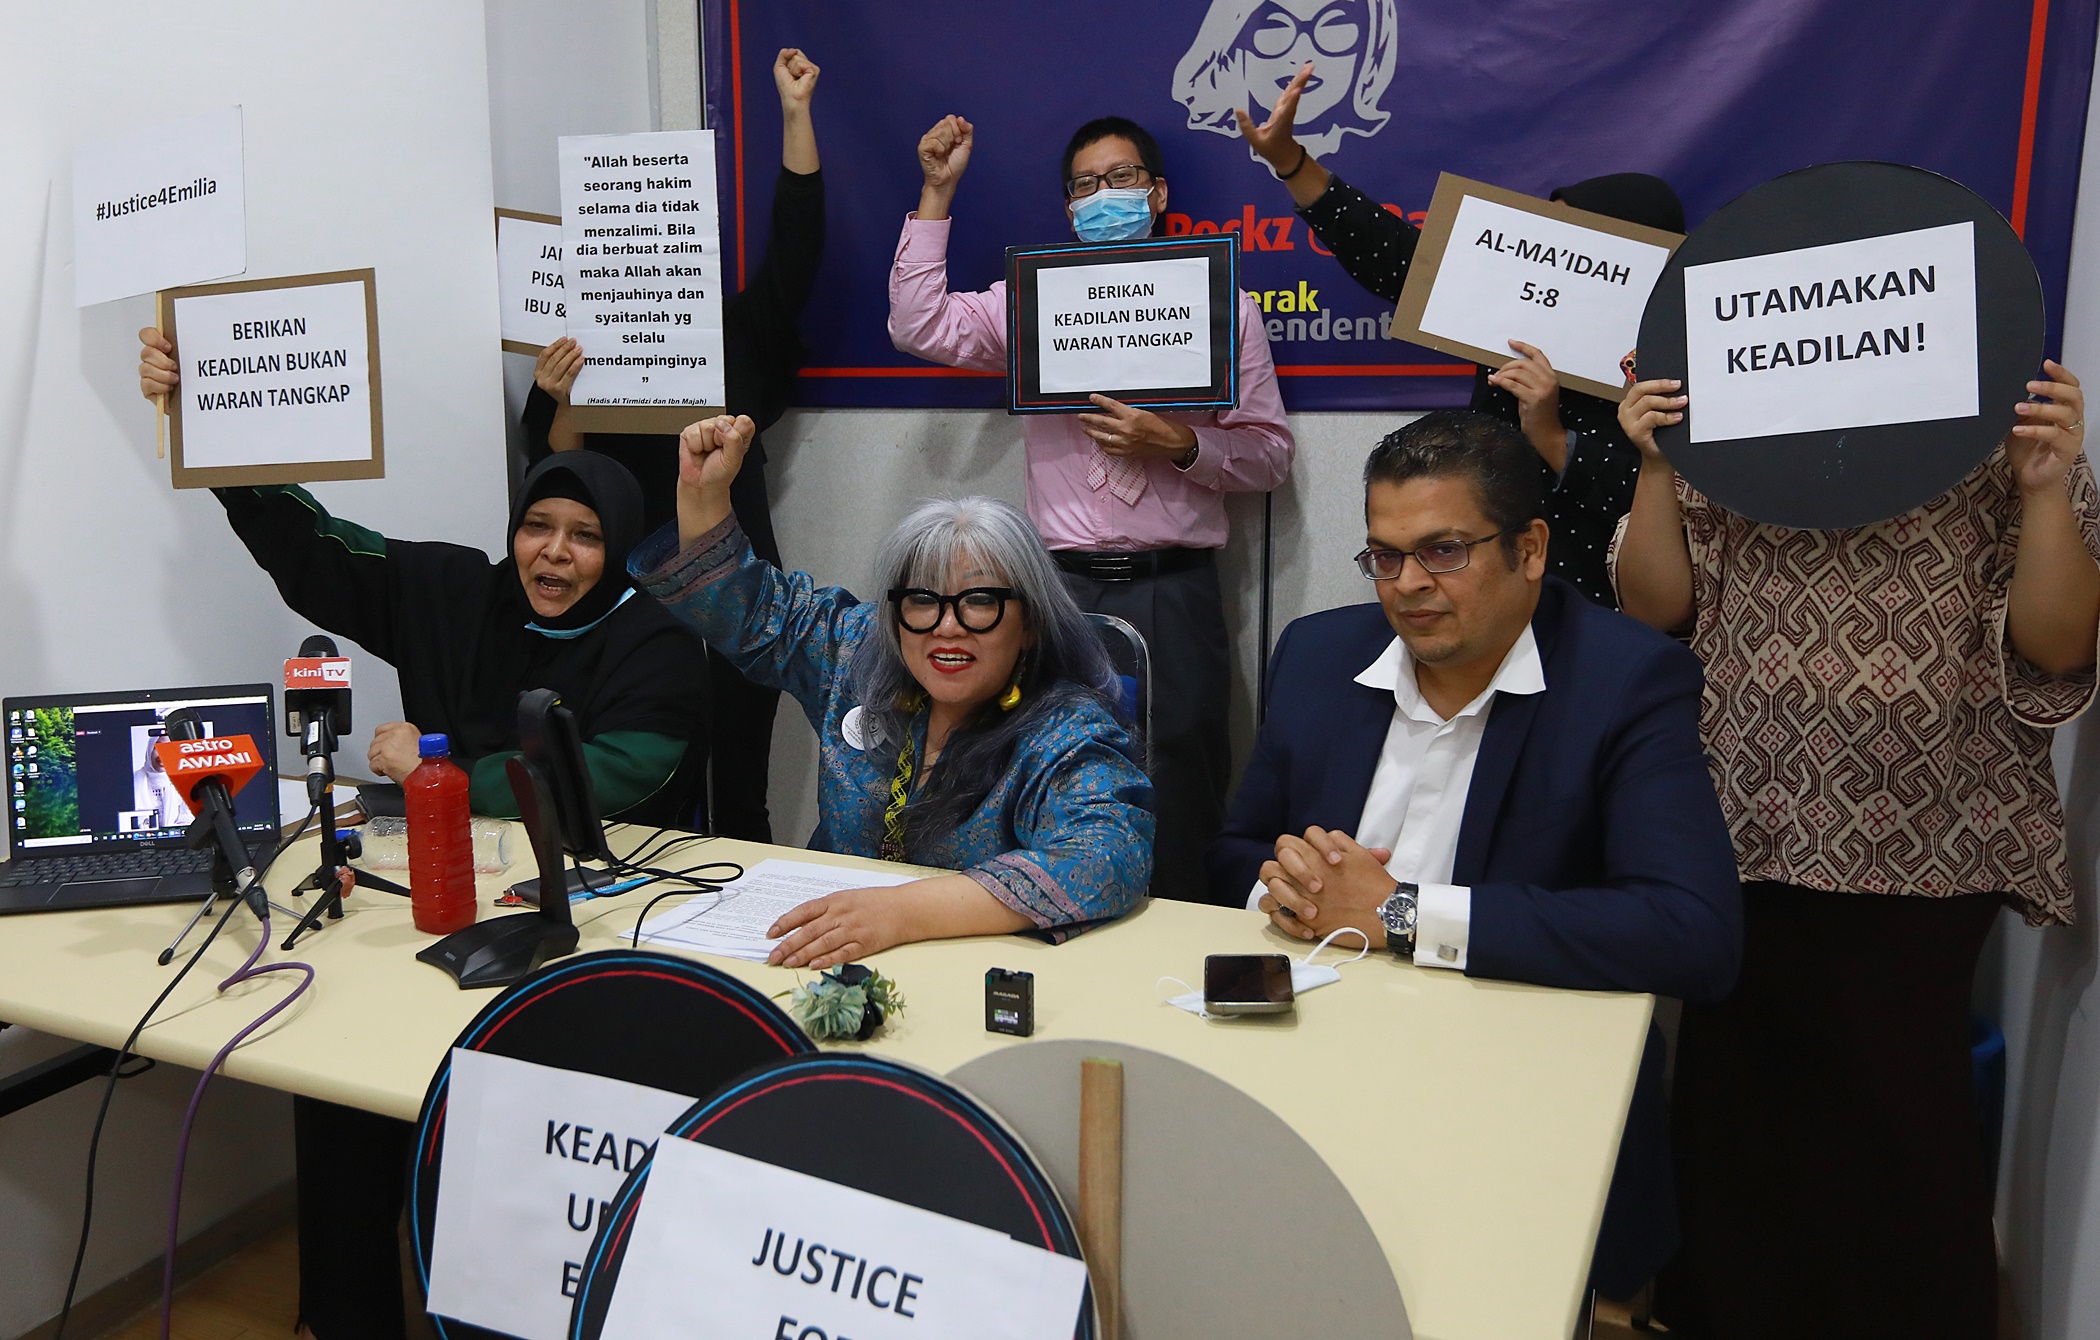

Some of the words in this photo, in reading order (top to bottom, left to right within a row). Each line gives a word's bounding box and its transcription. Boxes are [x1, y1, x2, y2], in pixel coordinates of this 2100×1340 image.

[584, 155, 628, 168] "Allah
[632, 153, 689, 167] beserta
[584, 179, 642, 193] seorang
[647, 177, 692, 190] hakim
[96, 177, 217, 221] #Justice4Emilia
[578, 203, 630, 215] selama
[635, 201, 657, 213] dia
[662, 200, 700, 213] tidak
[584, 224, 662, 238] menzalimi.
[668, 224, 696, 236] Bila
[576, 244, 598, 256] dia
[602, 243, 658, 255] berbuat
[663, 242, 703, 254] zalim
[532, 270, 565, 289] PISA
[580, 266, 619, 278] maka
[624, 265, 661, 278] Allah
[666, 265, 702, 277] akan
[581, 288, 672, 303] menjauhinya
[677, 288, 704, 300] dan
[1088, 283, 1154, 300] BERIKAN
[1519, 281, 1560, 308] 5:8
[1714, 265, 1936, 322] UTAMAKAN
[525, 298, 550, 315] IBU
[555, 303, 567, 318] &
[1054, 309, 1130, 327] KEADILAN
[1135, 306, 1190, 323] BUKAN
[595, 311, 670, 325] syaitanlah
[675, 313, 692, 325] yg
[232, 317, 306, 341] BERIKAN
[622, 332, 665, 344] selalu
[1052, 335, 1112, 352] WARAN
[1116, 331, 1193, 349] TANGKAP
[1726, 321, 1926, 374] KEADILAN!
[197, 354, 281, 378] KEADILAN
[286, 349, 347, 371] BUKAN
[584, 354, 707, 369] mendampinginya
[197, 390, 263, 411] WARAN
[267, 384, 350, 407] TANGKAP
[587, 397, 611, 405] (Hadis
[682, 398, 707, 406] Majah)
[293, 667, 322, 677] kini
[326, 669, 345, 677] TV
[180, 739, 233, 754] astro
[178, 752, 252, 771] AWANI
[752, 1227, 924, 1319] JUSTICE
